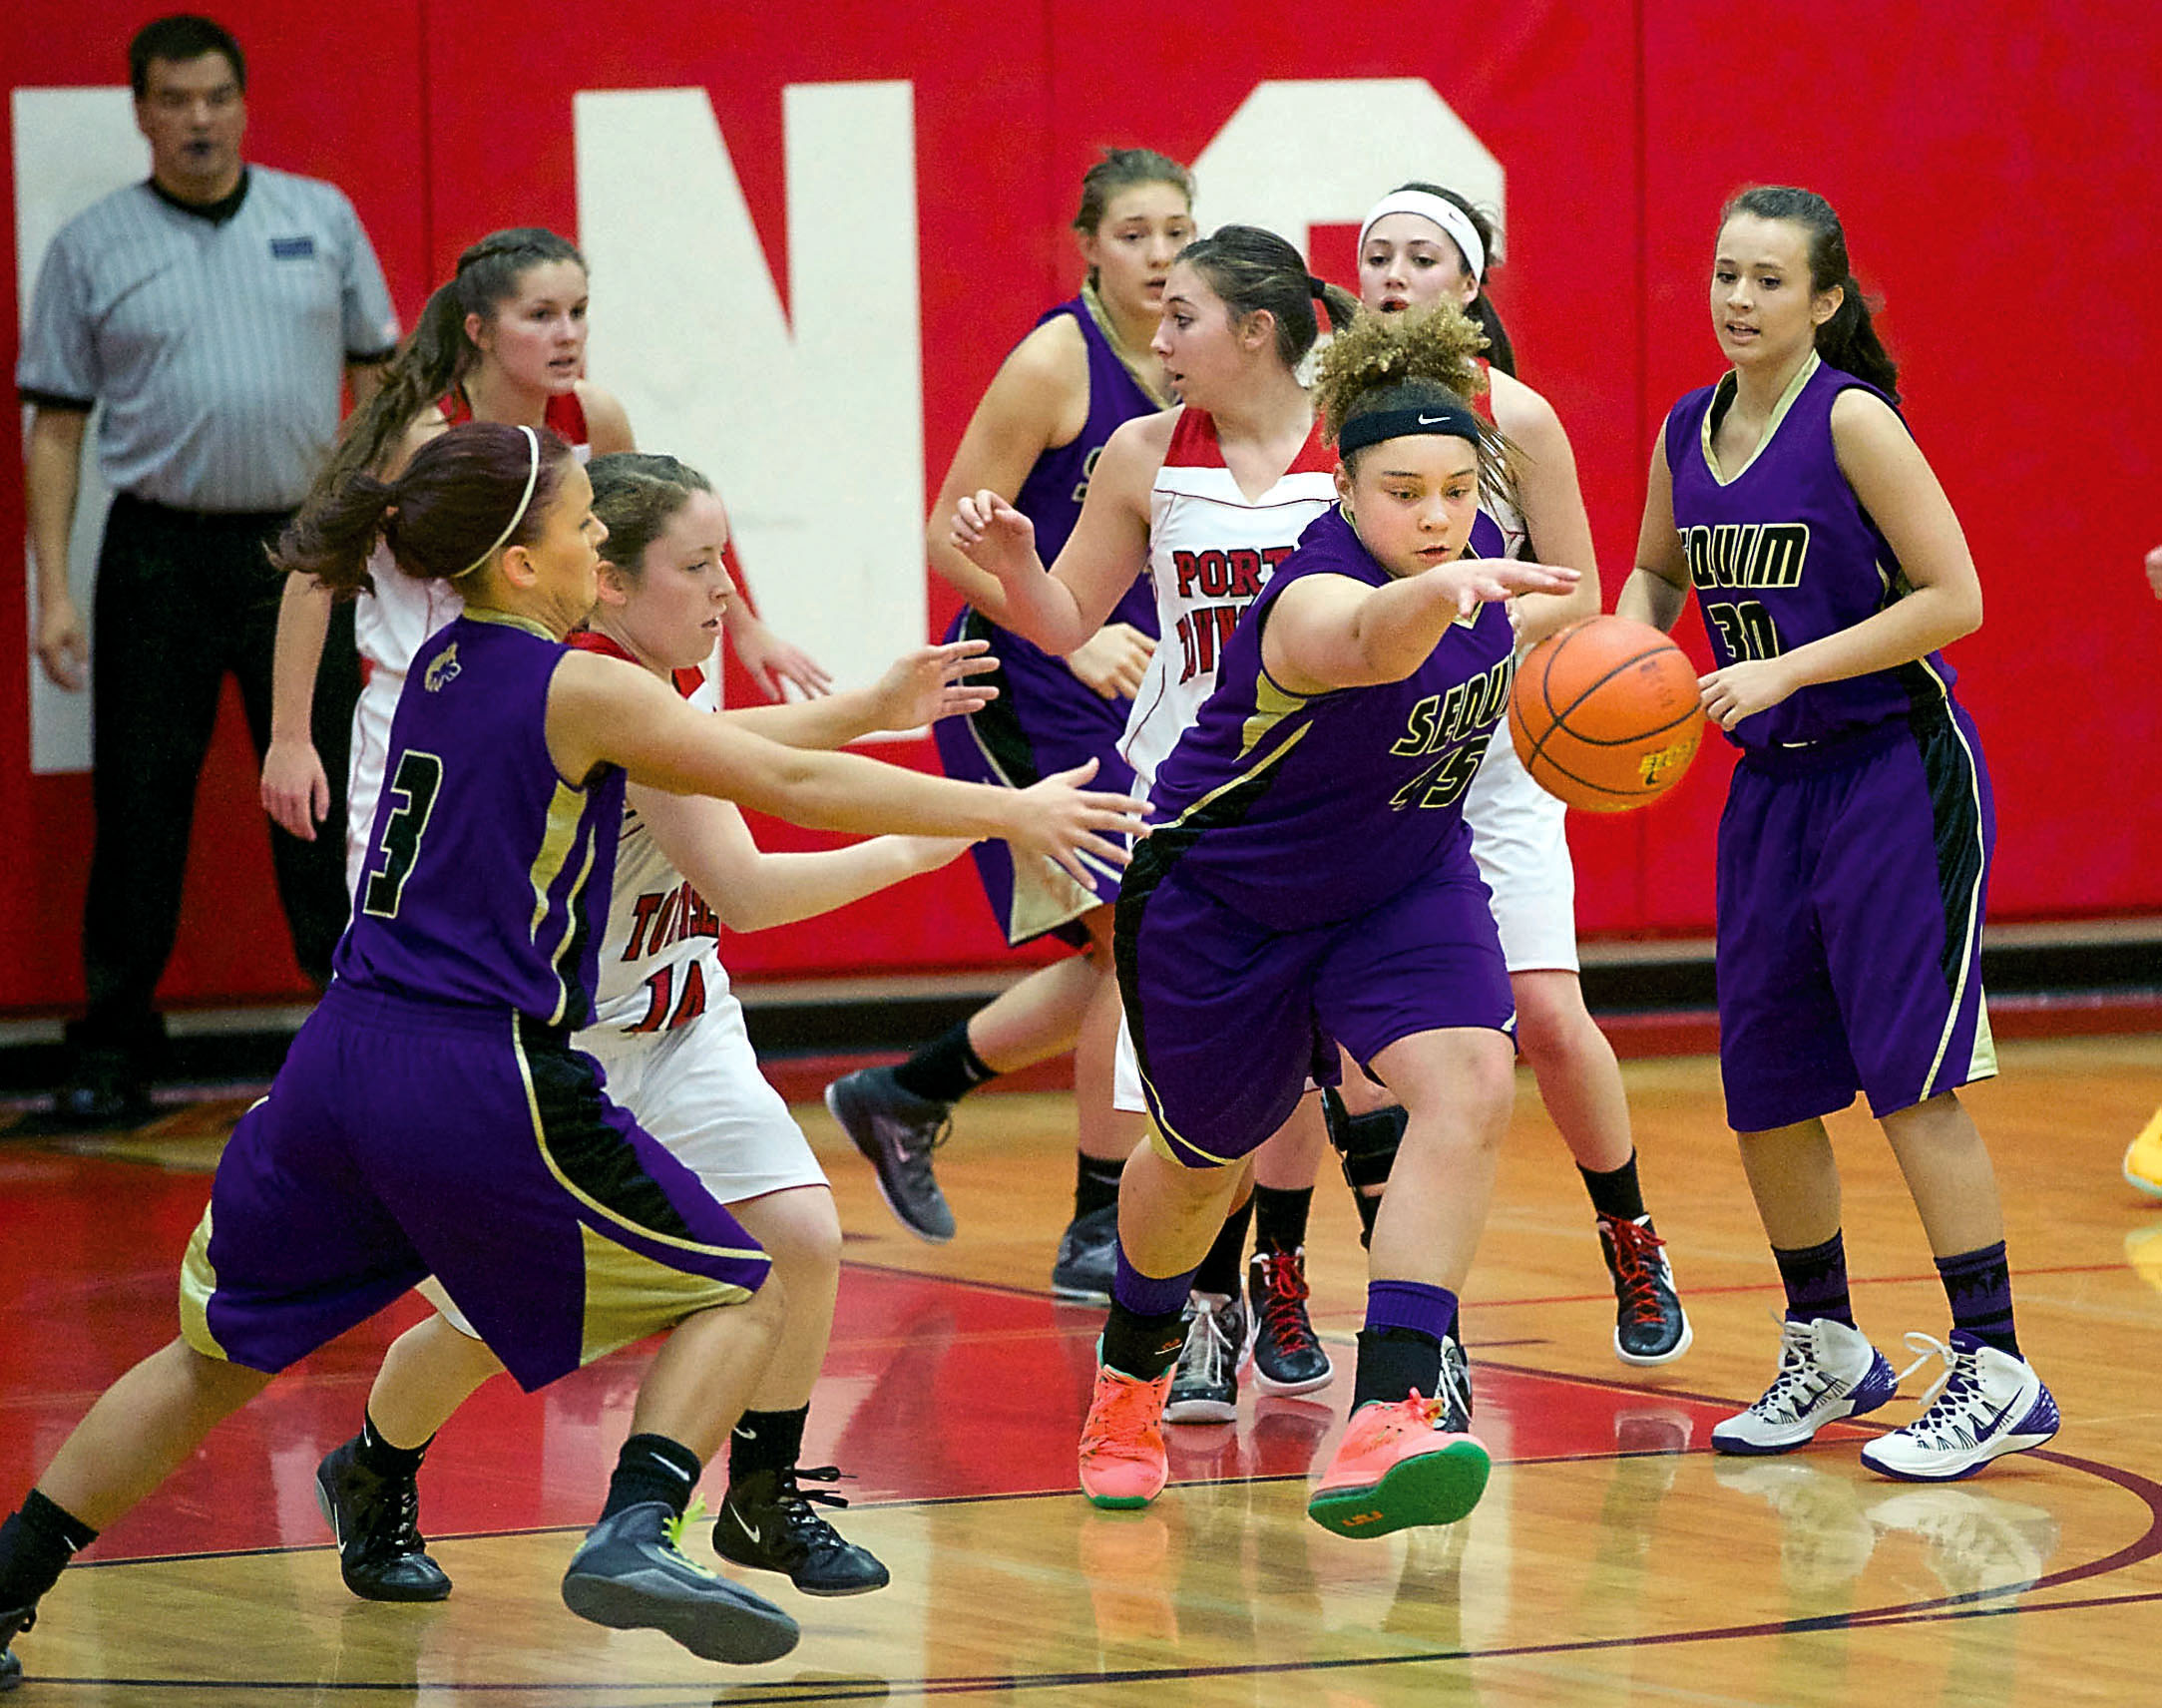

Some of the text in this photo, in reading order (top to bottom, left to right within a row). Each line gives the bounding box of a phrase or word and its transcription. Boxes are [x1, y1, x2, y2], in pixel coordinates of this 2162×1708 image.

[1677, 523, 1811, 590] QUIM
[1707, 601, 1780, 661] 30
[363, 749, 443, 919] 3
